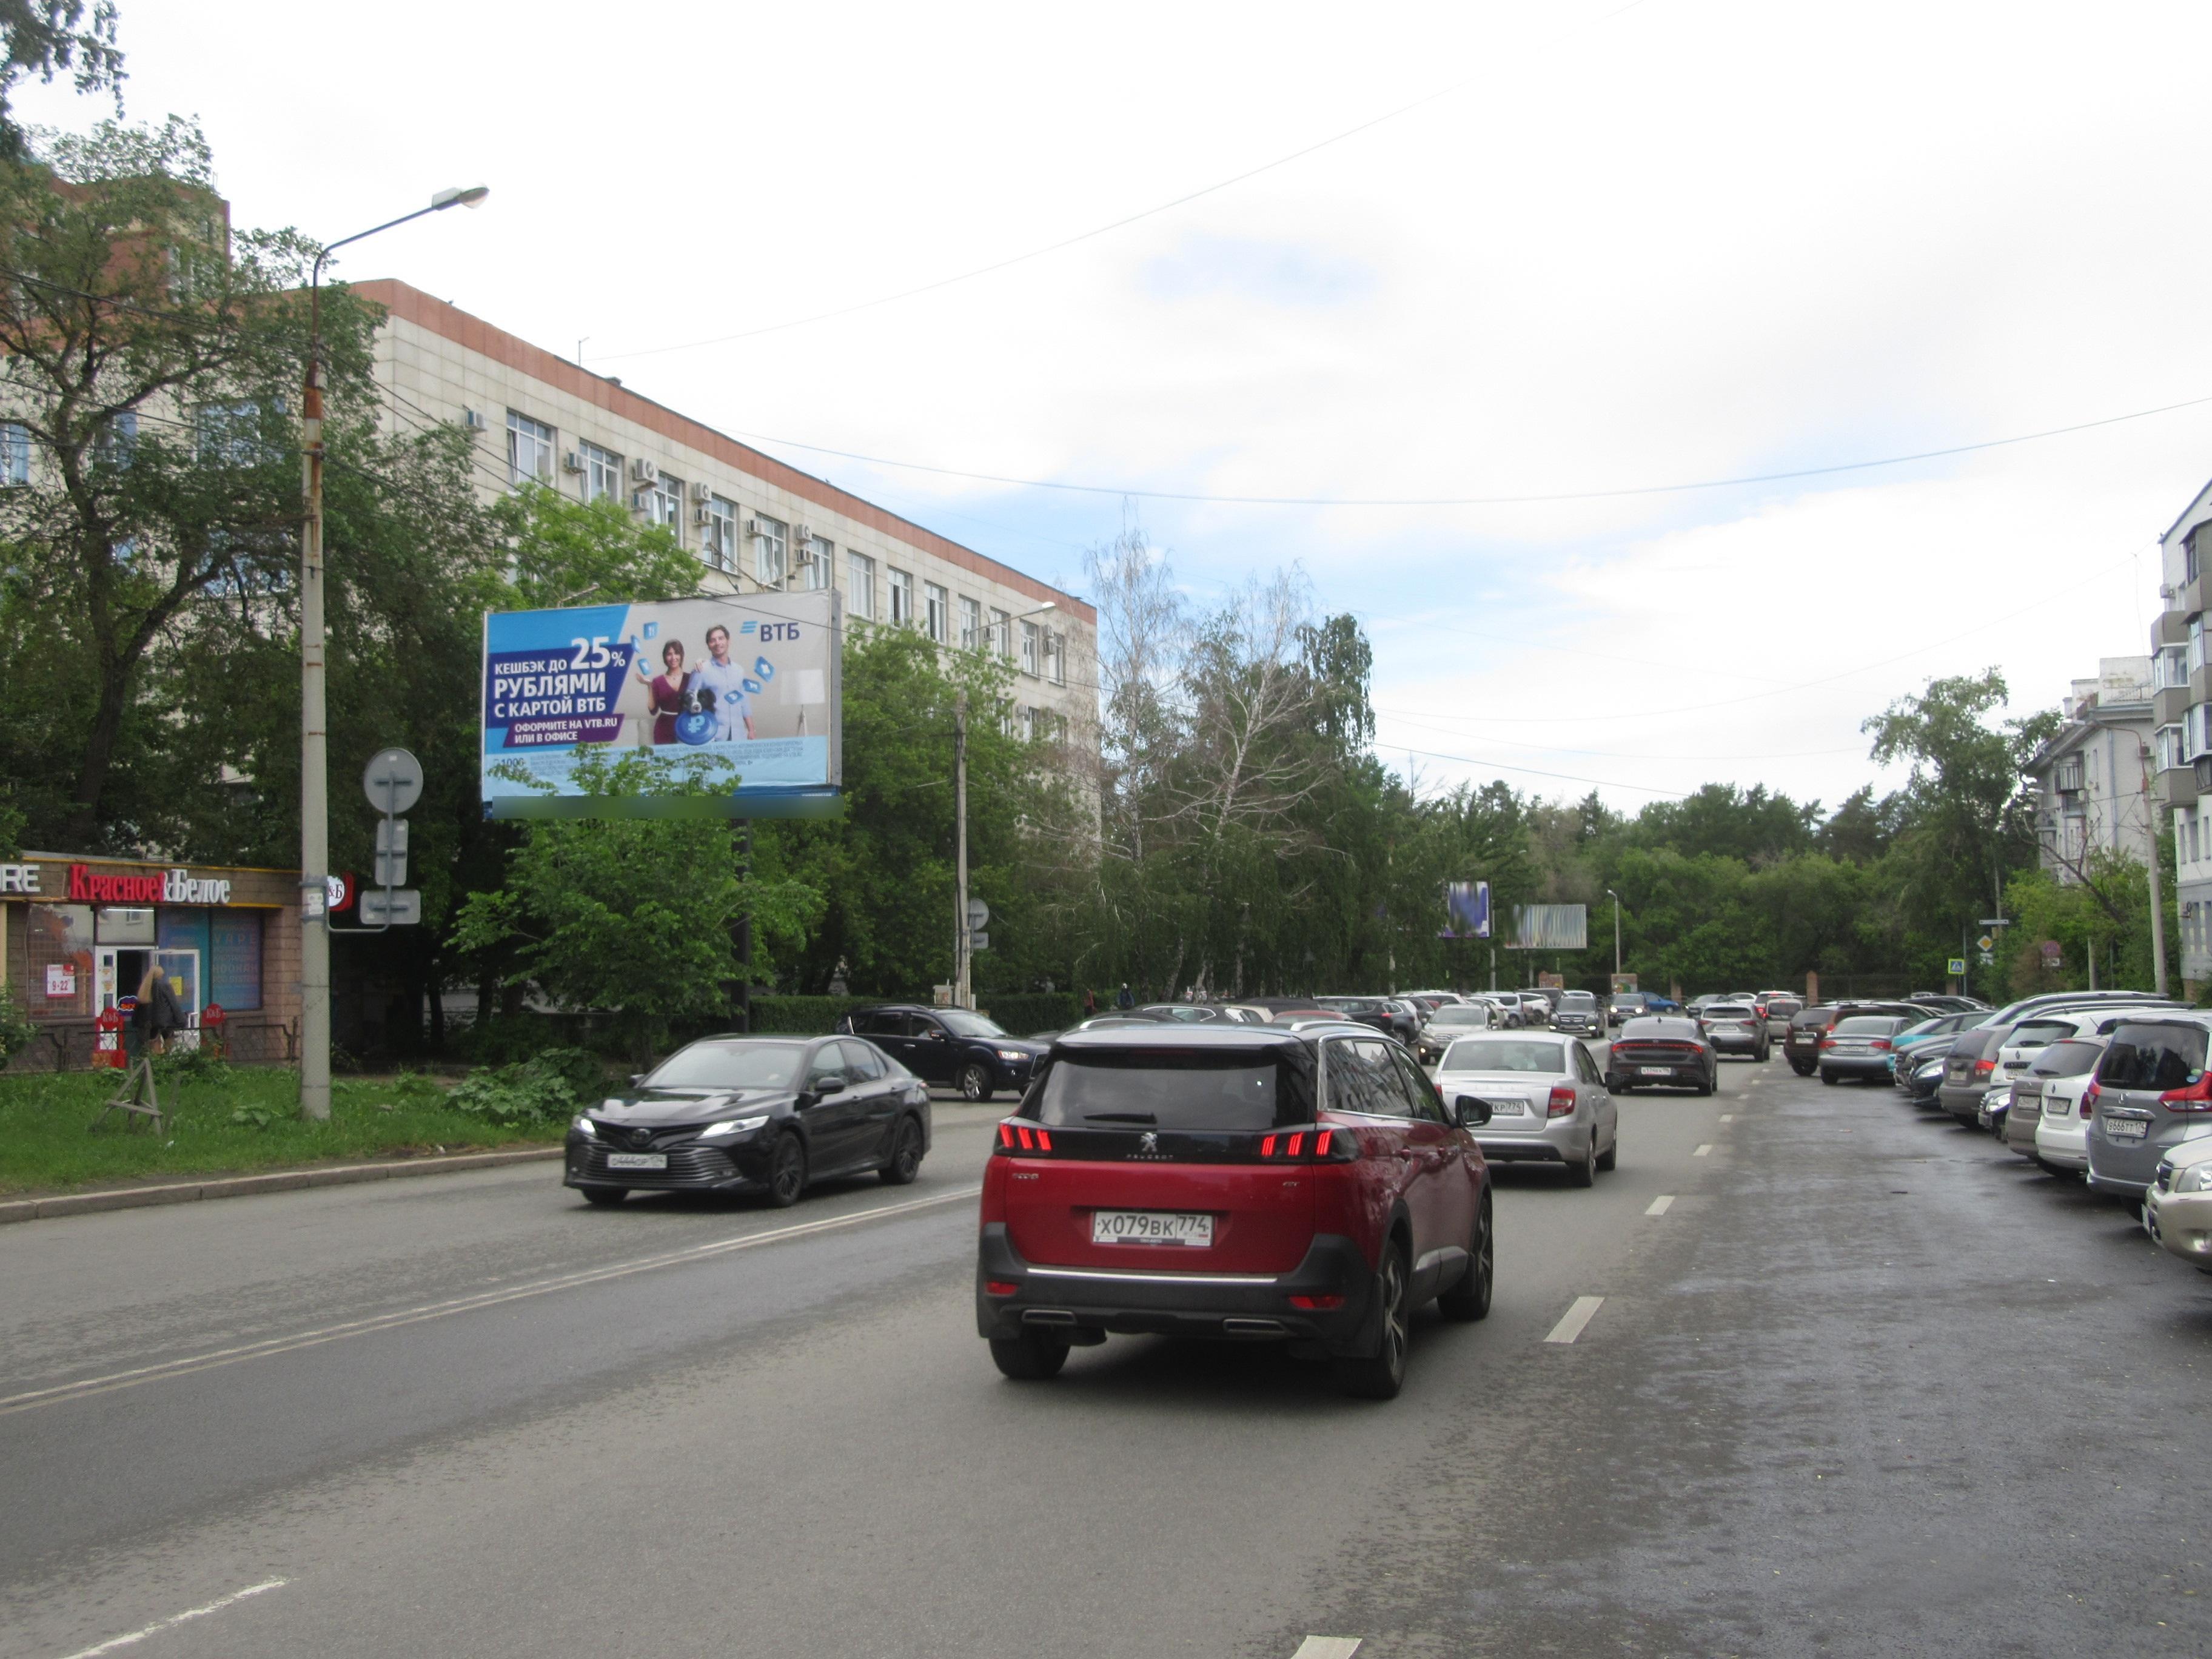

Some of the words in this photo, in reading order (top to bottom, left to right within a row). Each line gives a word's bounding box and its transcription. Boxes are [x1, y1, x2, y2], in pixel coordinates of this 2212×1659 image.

[760, 622, 800, 642] ВТБ
[495, 660, 545, 675] КЕШБЭК
[548, 659, 568, 673] ДО
[571, 636, 626, 670] 25%
[495, 672, 606, 699] РУБЛЯМИ
[494, 703, 505, 718] С
[509, 695, 572, 717] КАРТОЙ
[577, 697, 606, 713] ВТБ
[515, 720, 568, 733] ОФОРМИТЕ
[569, 720, 583, 730] НА
[585, 718, 618, 728] VTB.RU
[515, 734, 535, 744] ИЛИ
[537, 733, 543, 742] В
[545, 731, 578, 743] ОФИСЕ
[1178, 1216, 1207, 1232] 774
